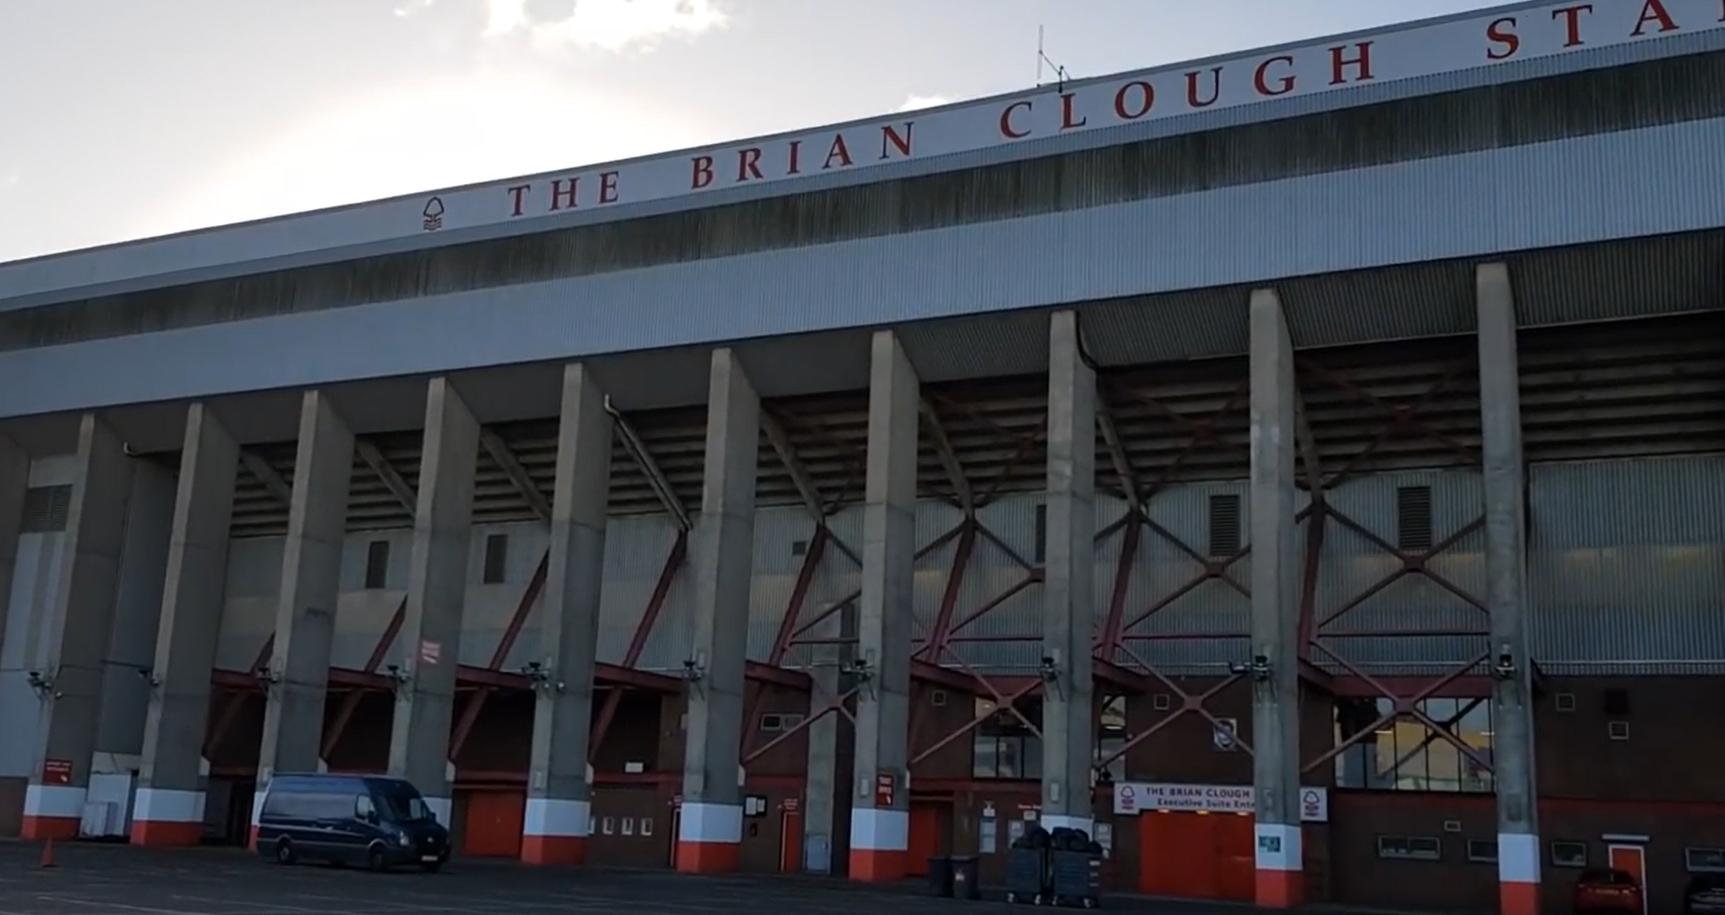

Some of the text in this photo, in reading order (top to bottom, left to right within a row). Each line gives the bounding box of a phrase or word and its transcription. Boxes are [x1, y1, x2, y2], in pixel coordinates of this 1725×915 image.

[507, 0, 1725, 217] THE BRIAN CLOUGH STA
[1146, 786, 1250, 798] THE BRIAN CLOUGH
